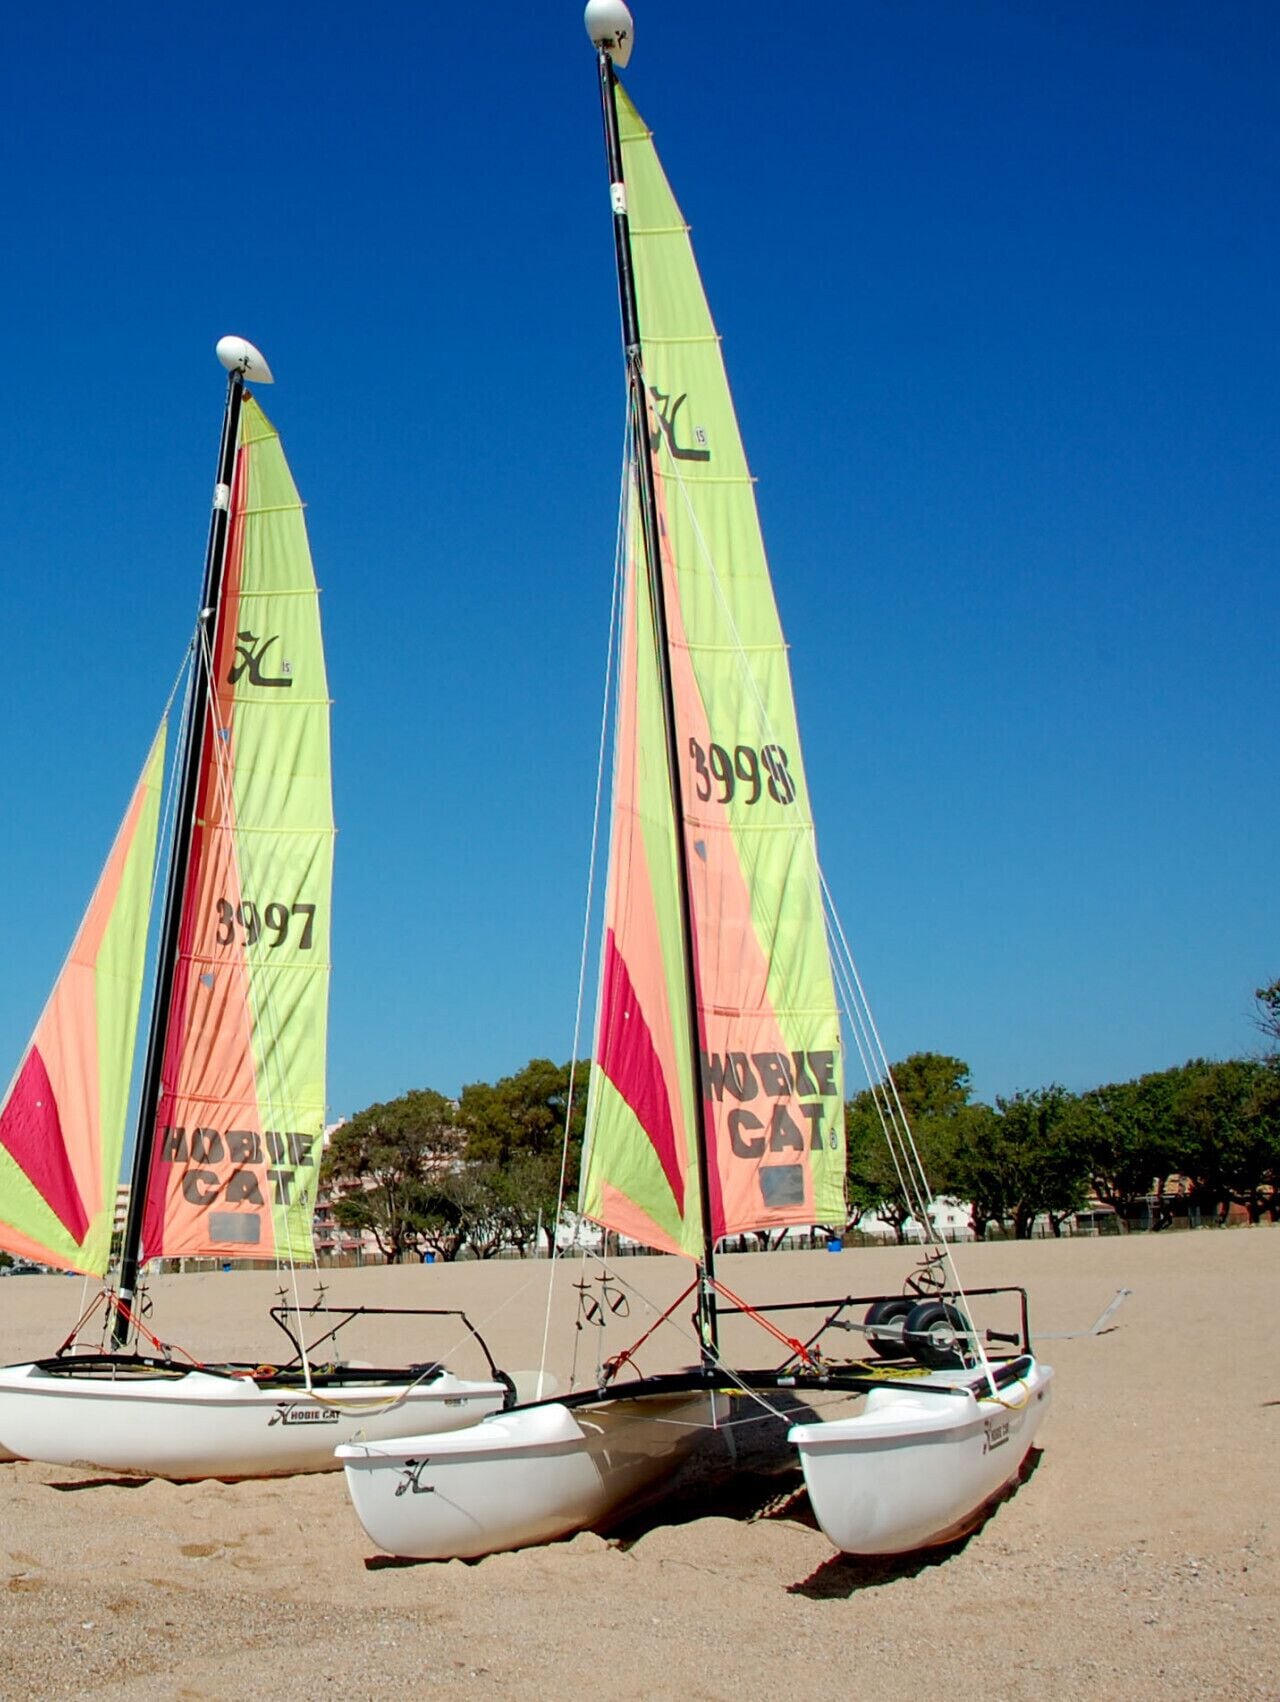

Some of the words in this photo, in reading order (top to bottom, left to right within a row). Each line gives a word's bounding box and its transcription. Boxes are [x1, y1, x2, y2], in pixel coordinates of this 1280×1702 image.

[689, 736, 796, 806] 3998
[216, 897, 317, 950] 3997
[700, 1050, 838, 1103] HOBIE
[161, 1126, 314, 1167] HOBIE
[727, 1102, 825, 1160] CAT
[182, 1168, 296, 1206] CAT
[290, 1410, 320, 1420] HOBIE
[322, 1409, 341, 1419] CAT
